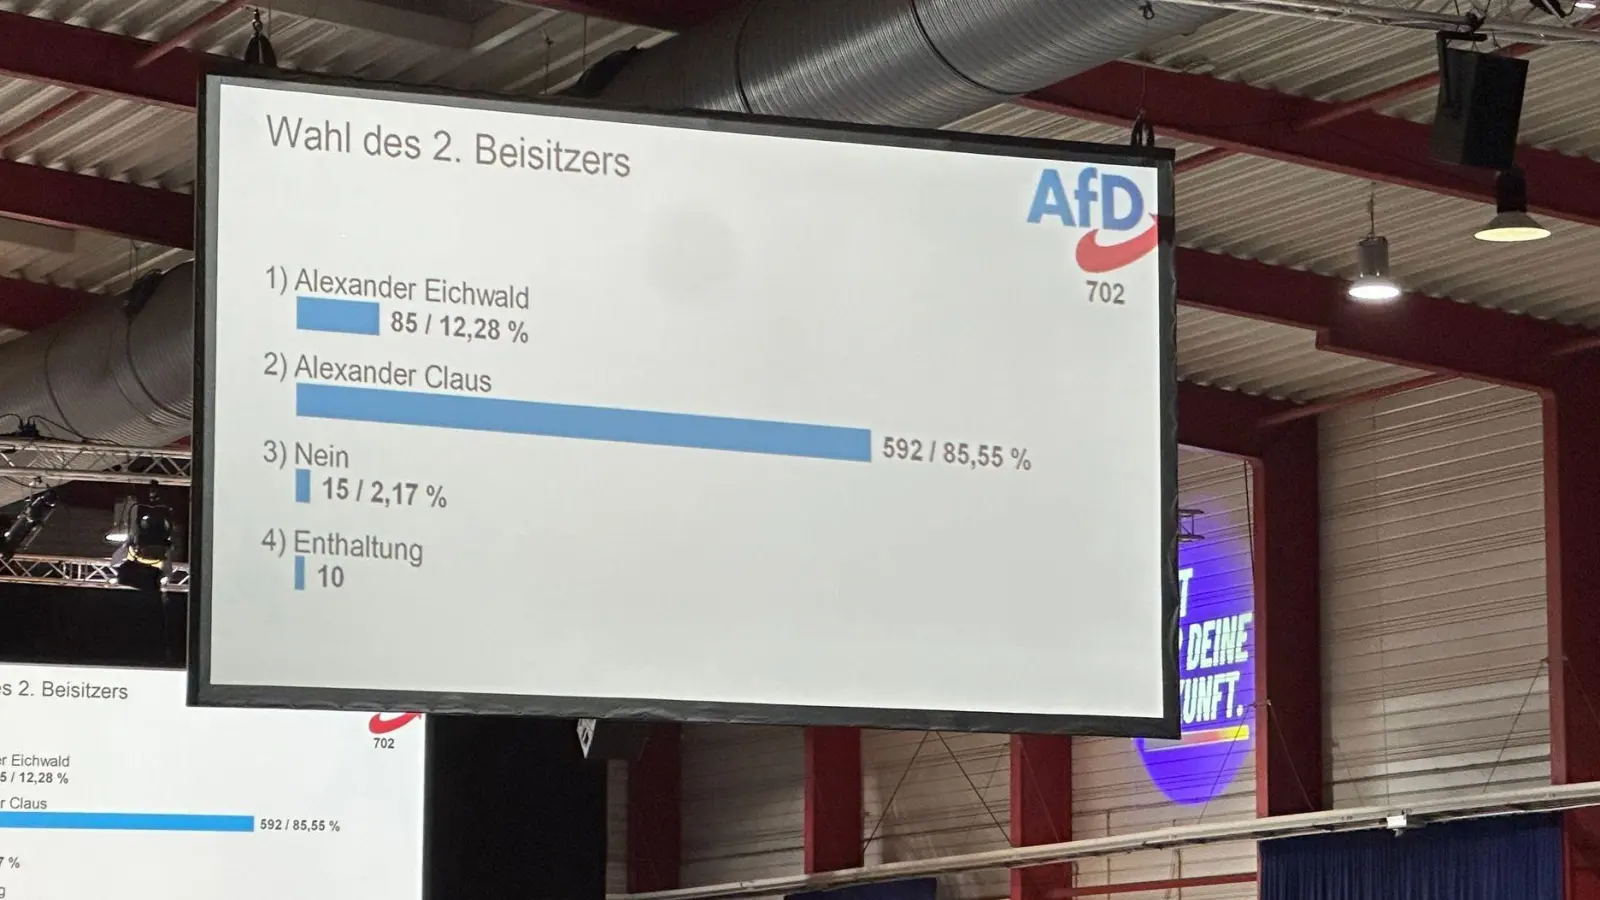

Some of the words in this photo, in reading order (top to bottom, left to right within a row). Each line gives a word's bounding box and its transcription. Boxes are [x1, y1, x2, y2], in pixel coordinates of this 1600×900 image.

[266, 114, 350, 153] Wahl
[364, 124, 421, 160] des
[433, 130, 460, 163] 2.
[476, 133, 630, 178] Beisitzers
[1027, 167, 1144, 231] AfD
[266, 265, 287, 295] 1)
[294, 268, 417, 301] Alexander
[425, 278, 529, 310] Eichwald
[1086, 280, 1125, 305] 702
[391, 311, 417, 333] 85
[425, 313, 432, 335] /
[440, 315, 500, 343] 12,28
[508, 320, 528, 344] %
[264, 352, 287, 382] 2)
[294, 354, 417, 387] Alexander
[424, 364, 492, 392] Claus
[264, 440, 287, 470] 3)
[295, 442, 348, 468] Nein
[883, 436, 923, 461] 592
[929, 441, 936, 462] /
[943, 442, 1003, 470] 85,55
[1011, 448, 1031, 470] %
[323, 477, 349, 500] 15
[356, 479, 363, 502] /
[371, 480, 418, 508] 2,17
[426, 485, 447, 508] %
[261, 528, 286, 558] 4)
[294, 530, 423, 567] Enthaltung
[318, 565, 344, 588] 10
[1186, 612, 1253, 671] DEINE
[0, 684, 12, 696] s
[18, 680, 34, 696] 2.
[42, 681, 128, 700] Beisitzers
[373, 737, 394, 749] 702
[0, 757, 7, 766] r
[11, 754, 70, 767] Eichwald
[11, 772, 15, 782] /
[19, 772, 53, 785] 12,28
[57, 772, 69, 784] %
[10, 797, 47, 809] Claus
[260, 819, 282, 830] 592
[285, 819, 290, 830] /
[293, 820, 325, 832] 85,55
[329, 820, 340, 832] %
[8, 857, 20, 868] %
